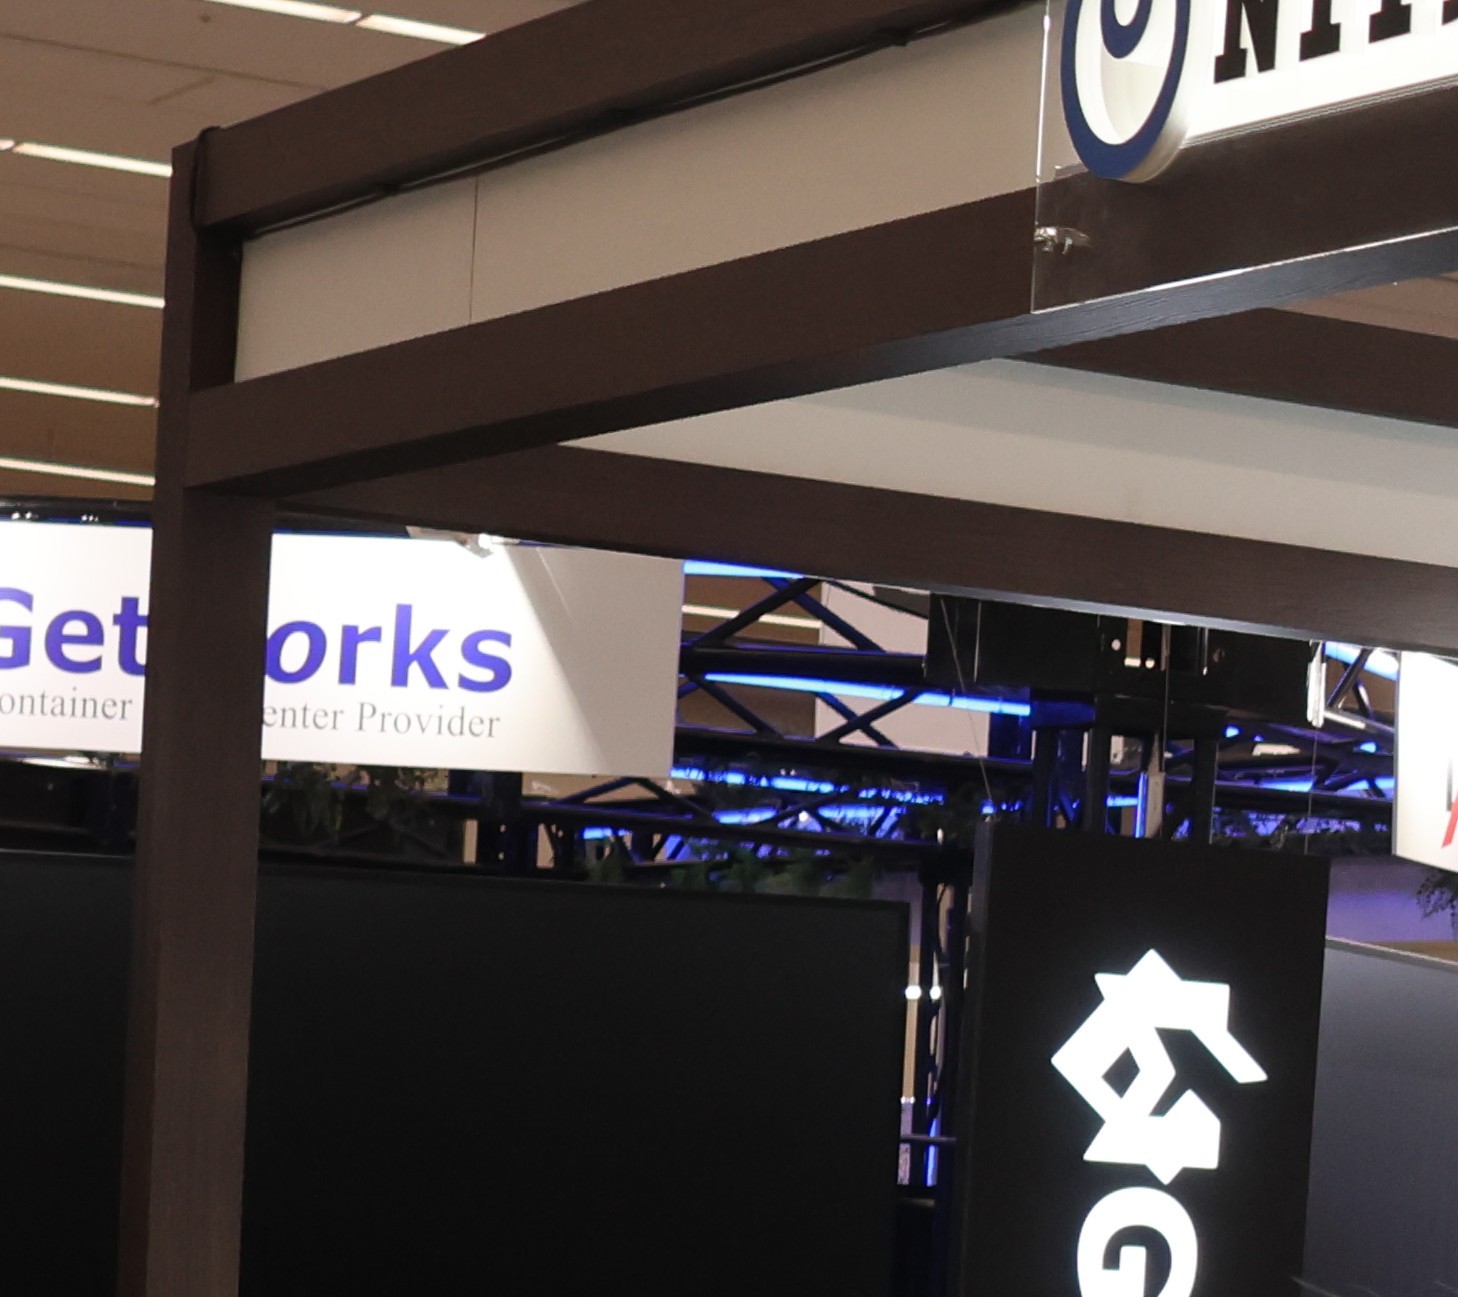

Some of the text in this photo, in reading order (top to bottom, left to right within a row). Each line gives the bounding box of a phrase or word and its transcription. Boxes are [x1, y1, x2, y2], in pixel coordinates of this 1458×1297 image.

[0, 585, 513, 693] Getorks
[0, 687, 501, 739] ontainer enter Provider
